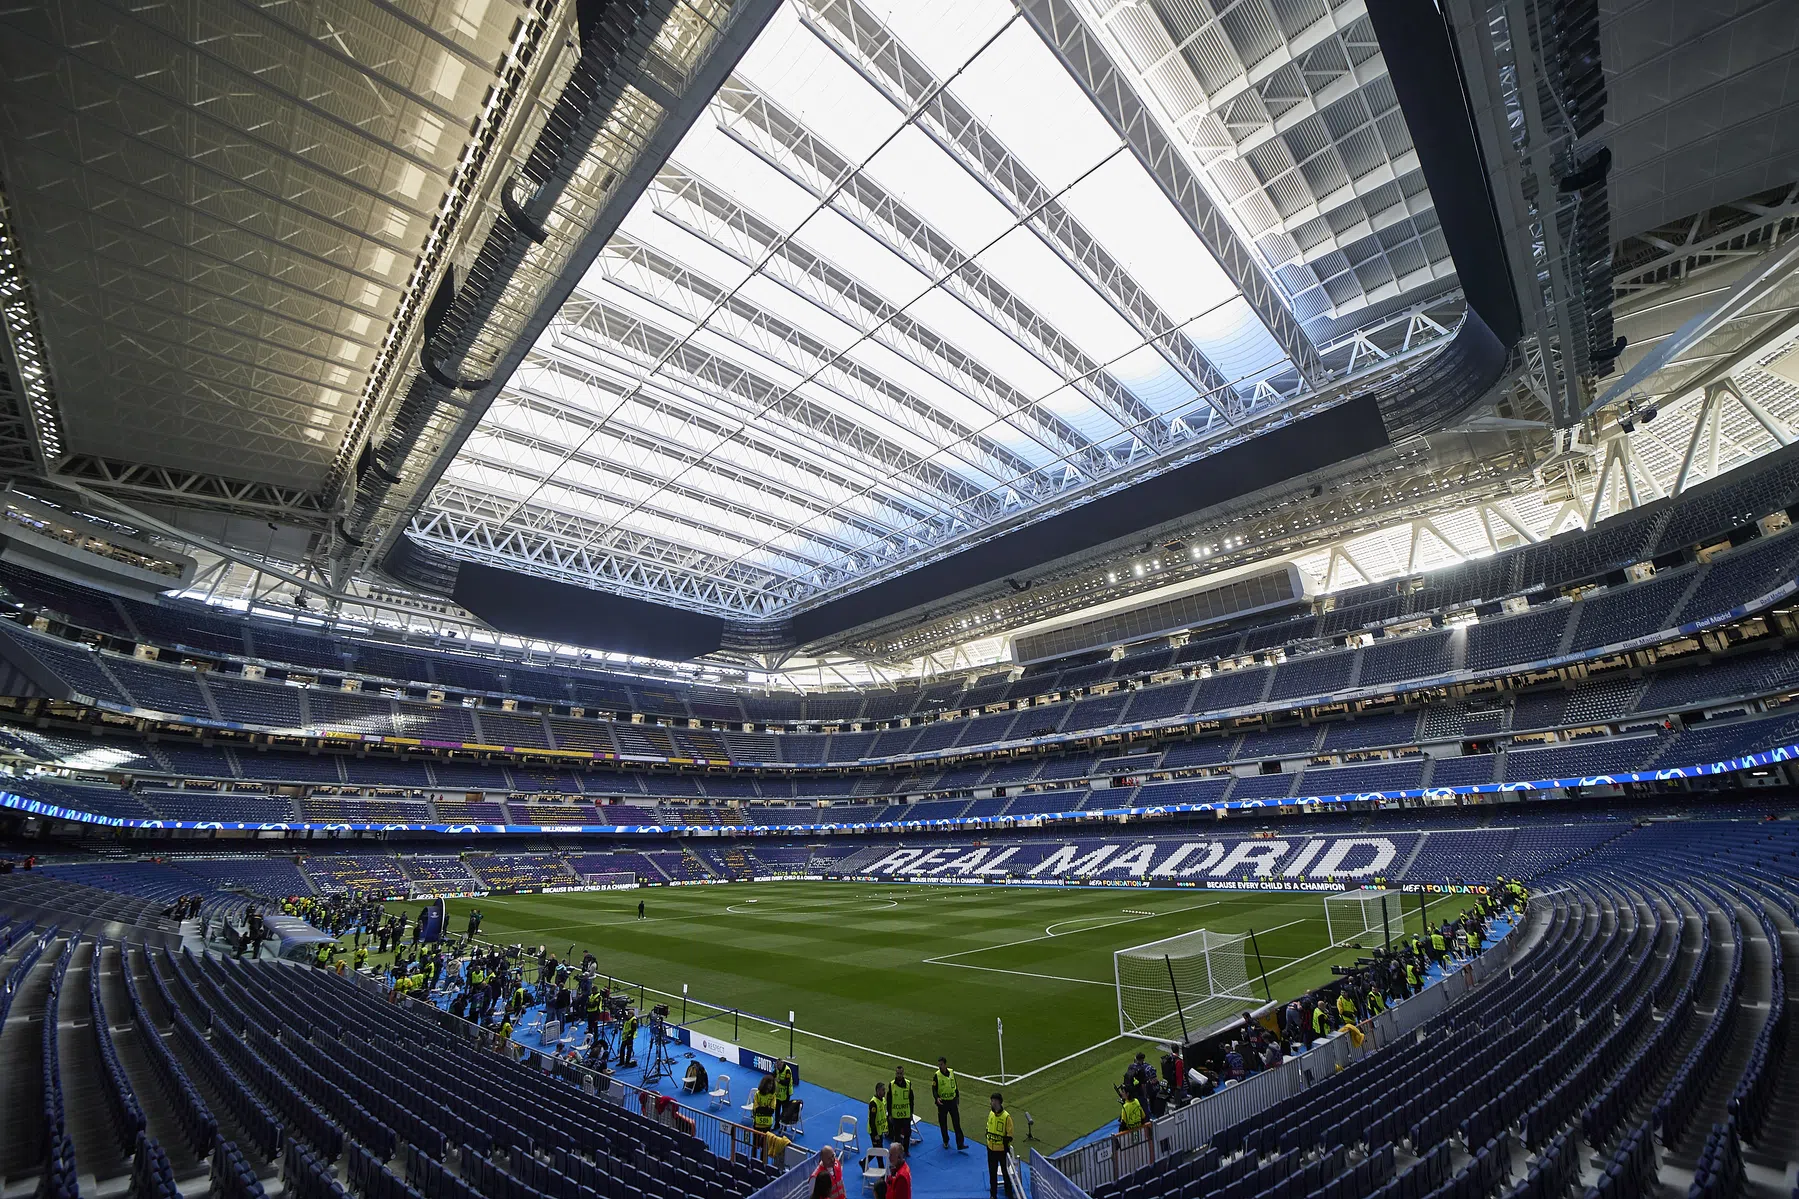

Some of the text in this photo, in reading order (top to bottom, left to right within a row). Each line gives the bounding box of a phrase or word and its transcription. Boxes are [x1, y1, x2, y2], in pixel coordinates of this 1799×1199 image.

[1695, 611, 1732, 629] Real Madrid
[1622, 635, 1662, 649] Real Madrid
[1547, 652, 1586, 665] Real Madrid
[1488, 668, 1512, 676] Madrid
[860, 838, 1398, 879] REAL MADRID
[1206, 881, 1237, 889] BECAUSE
[1237, 881, 1259, 889] EVERY
[1260, 882, 1283, 890] CHILD
[1284, 882, 1292, 890] IS
[1300, 883, 1346, 891] CHAMPION
[1426, 884, 1490, 894] FOUNDATIO
[707, 1042, 725, 1054] RESPECT
